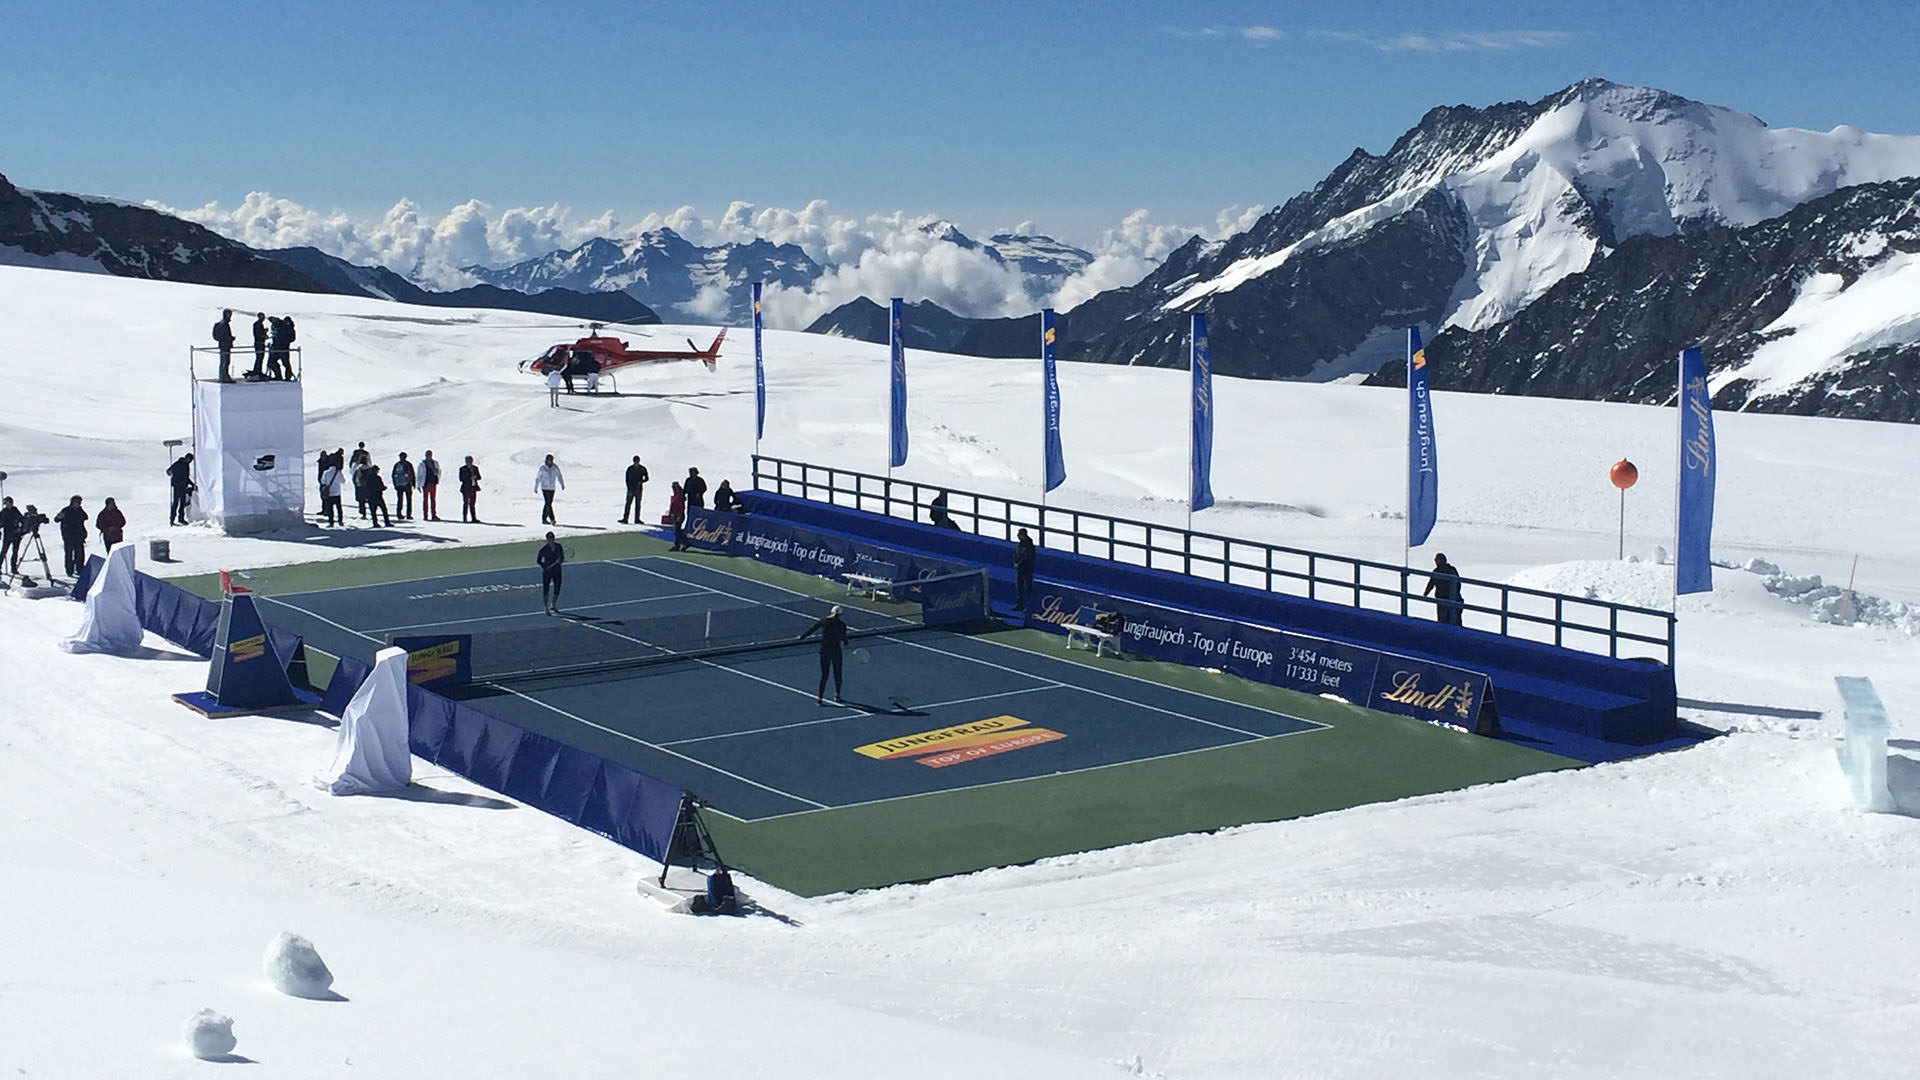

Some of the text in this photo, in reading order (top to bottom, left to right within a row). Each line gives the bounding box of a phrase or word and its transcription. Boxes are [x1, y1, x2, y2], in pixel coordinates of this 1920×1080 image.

[1416, 380, 1433, 473] jungfrau.ch
[1686, 396, 1709, 477] Lindt
[687, 517, 727, 543] Lindt
[735, 531, 745, 542] at
[808, 546, 819, 560] of
[818, 548, 845, 570] Europe
[1032, 595, 1081, 624] Lind
[1123, 616, 1185, 645] ungfraujoch
[1217, 638, 1231, 655] of
[1232, 641, 1273, 667] Europe
[1319, 655, 1353, 673] meters
[1321, 671, 1341, 688] feet
[1380, 670, 1457, 711] Lindt
[875, 720, 1005, 752] JUNGFRAU
[927, 753, 961, 766] TOP
[965, 747, 986, 759] OF
